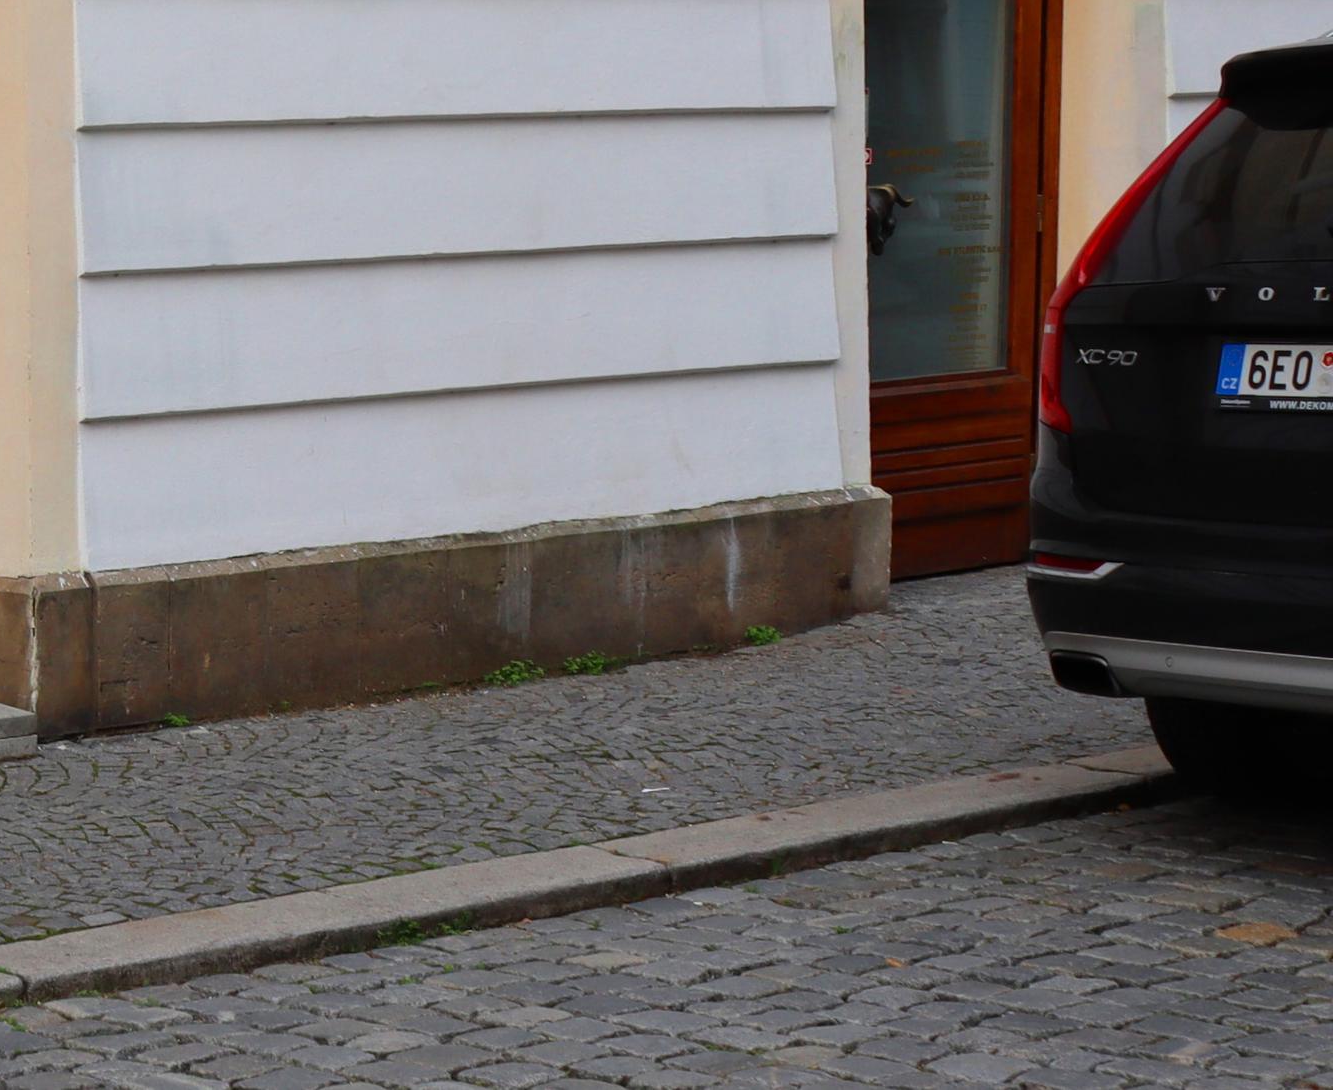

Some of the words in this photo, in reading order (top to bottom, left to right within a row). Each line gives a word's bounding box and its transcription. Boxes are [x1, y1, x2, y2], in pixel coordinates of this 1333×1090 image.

[1206, 286, 1331, 302] VOL
[1248, 350, 1313, 391] 6E0
[1220, 378, 1238, 390] CZ
